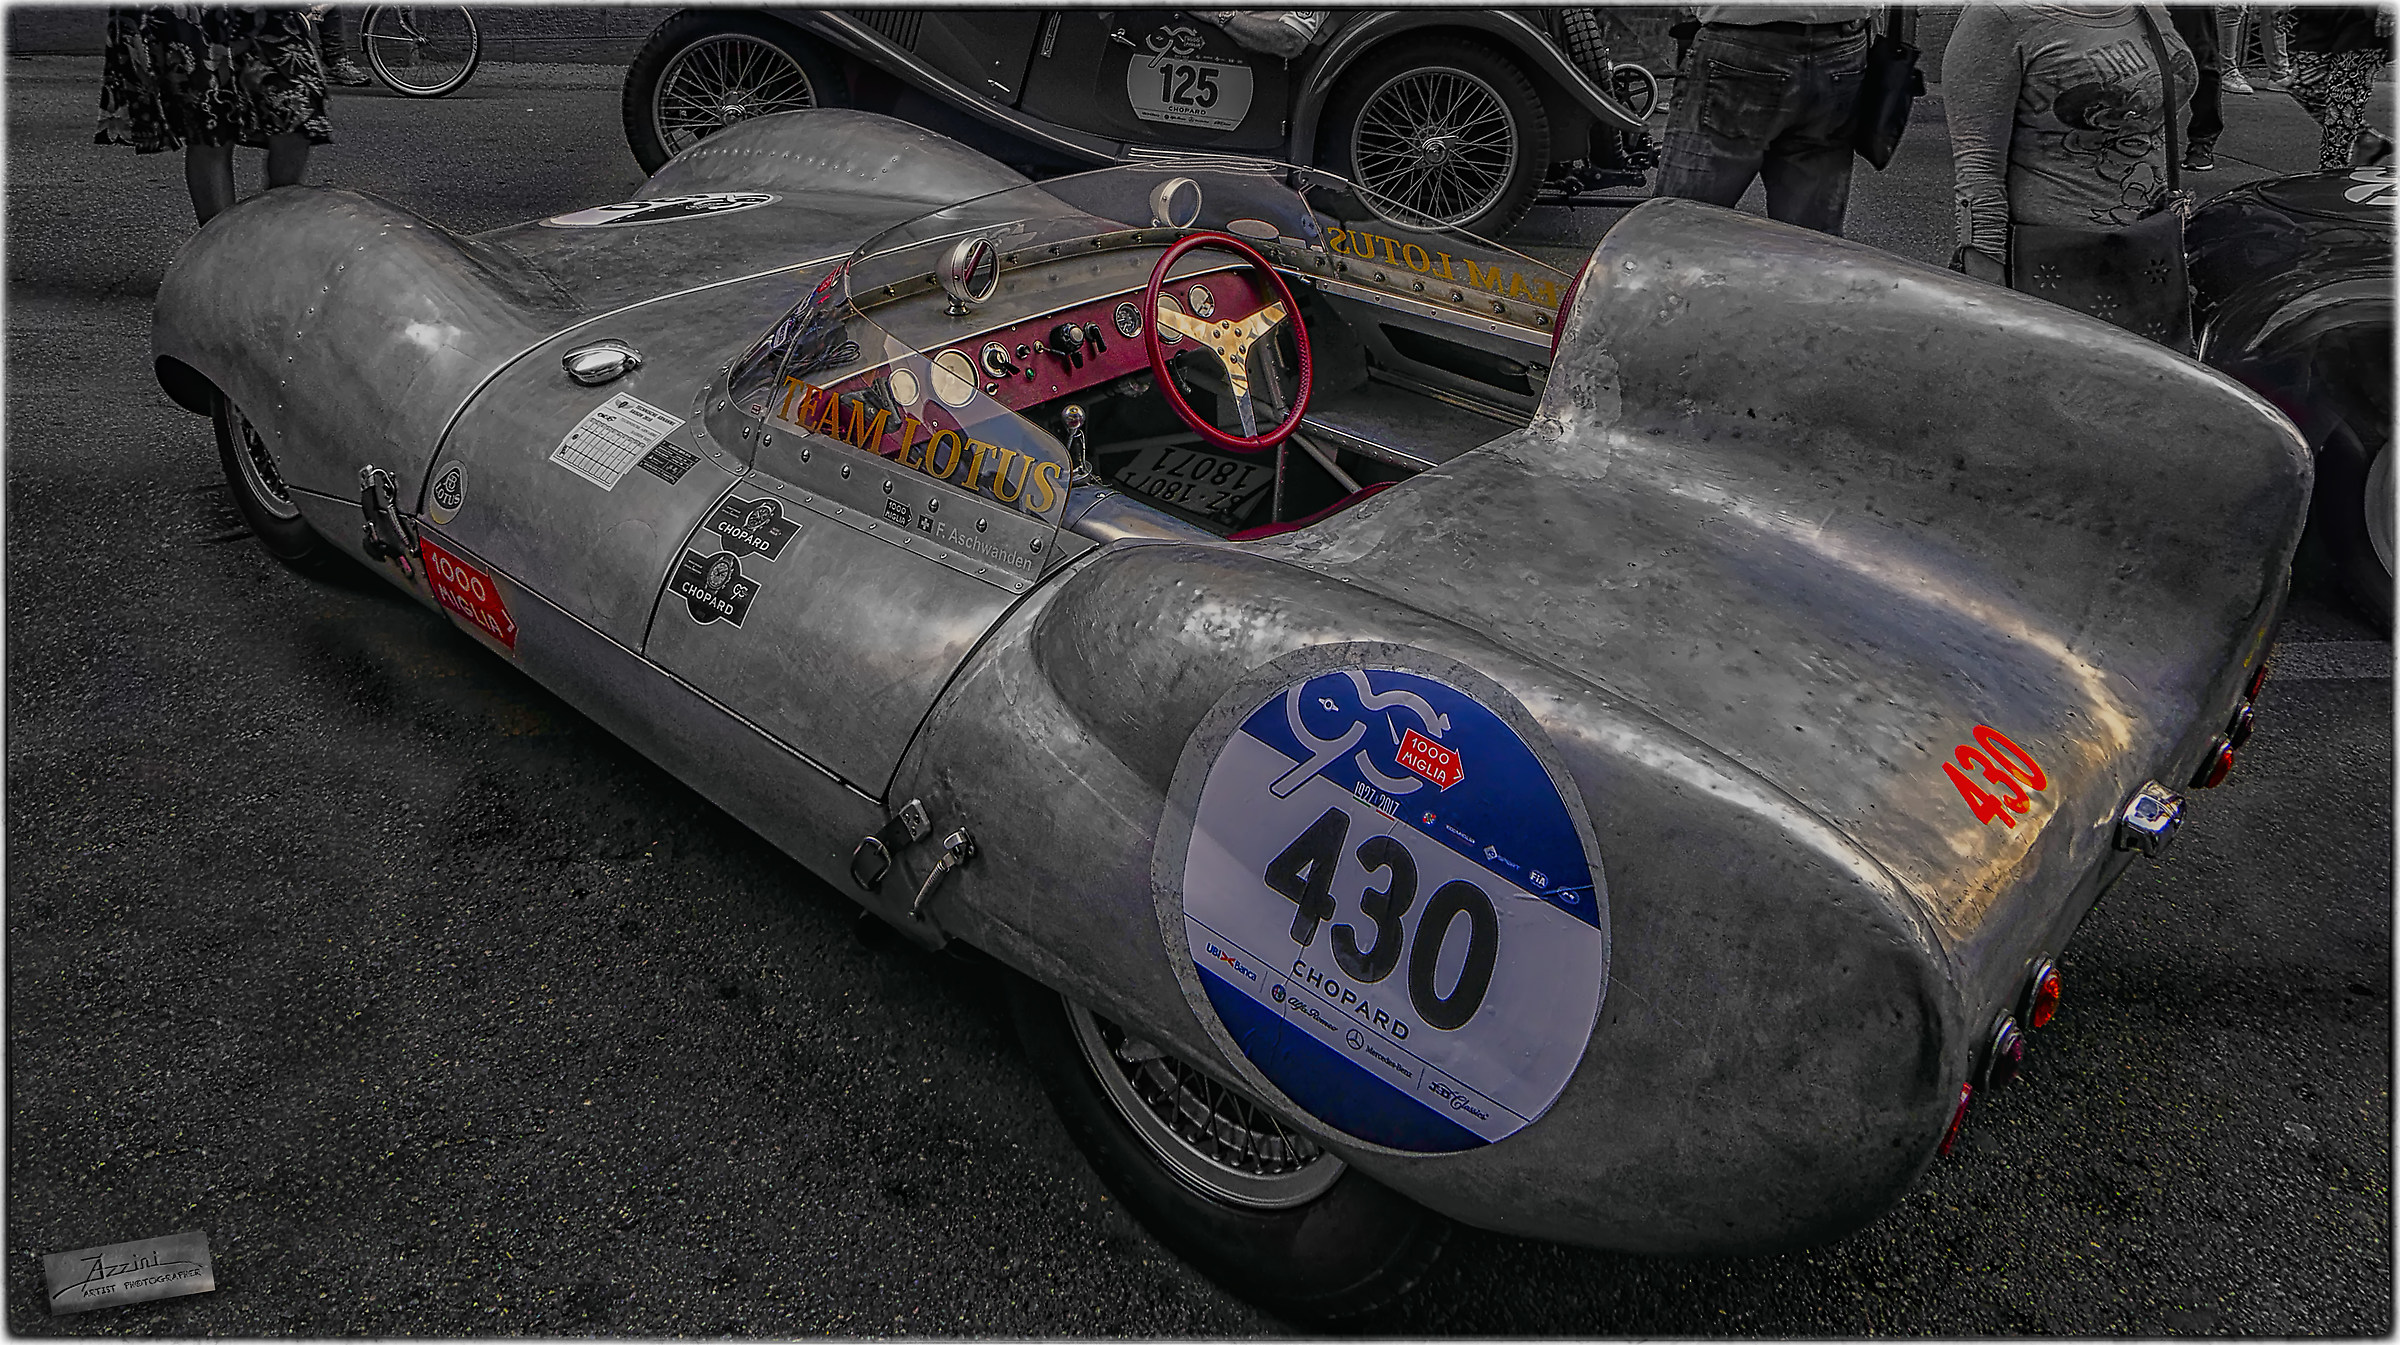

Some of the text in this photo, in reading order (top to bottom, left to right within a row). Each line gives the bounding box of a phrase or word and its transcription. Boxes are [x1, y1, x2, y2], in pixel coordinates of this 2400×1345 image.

[1160, 64, 1219, 108] 125
[1168, 106, 1206, 115] CHOPARD
[777, 375, 1062, 513] TEAM LOTUS
[1152, 447, 1256, 490] 18071
[434, 482, 461, 506] LOTUS
[888, 501, 906, 514] 1000
[717, 521, 770, 551] CHOPARD
[885, 511, 906, 525] MIGLIA
[936, 522, 1033, 572] F. Aschwanden
[432, 552, 486, 602] 1000
[438, 583, 504, 638] MIGLIA
[681, 581, 734, 615] CHOPARD
[1402, 751, 1446, 782] MIGLIA
[1411, 737, 1449, 765] 1000
[1942, 724, 2048, 829] 430
[1378, 793, 1400, 817] 2017
[1264, 806, 1499, 1031] 430
[1206, 943, 1257, 982] UBI Banca
[1292, 959, 1410, 1040] CHOPARD
[1365, 1045, 1413, 1078] Mercedes-Benz
